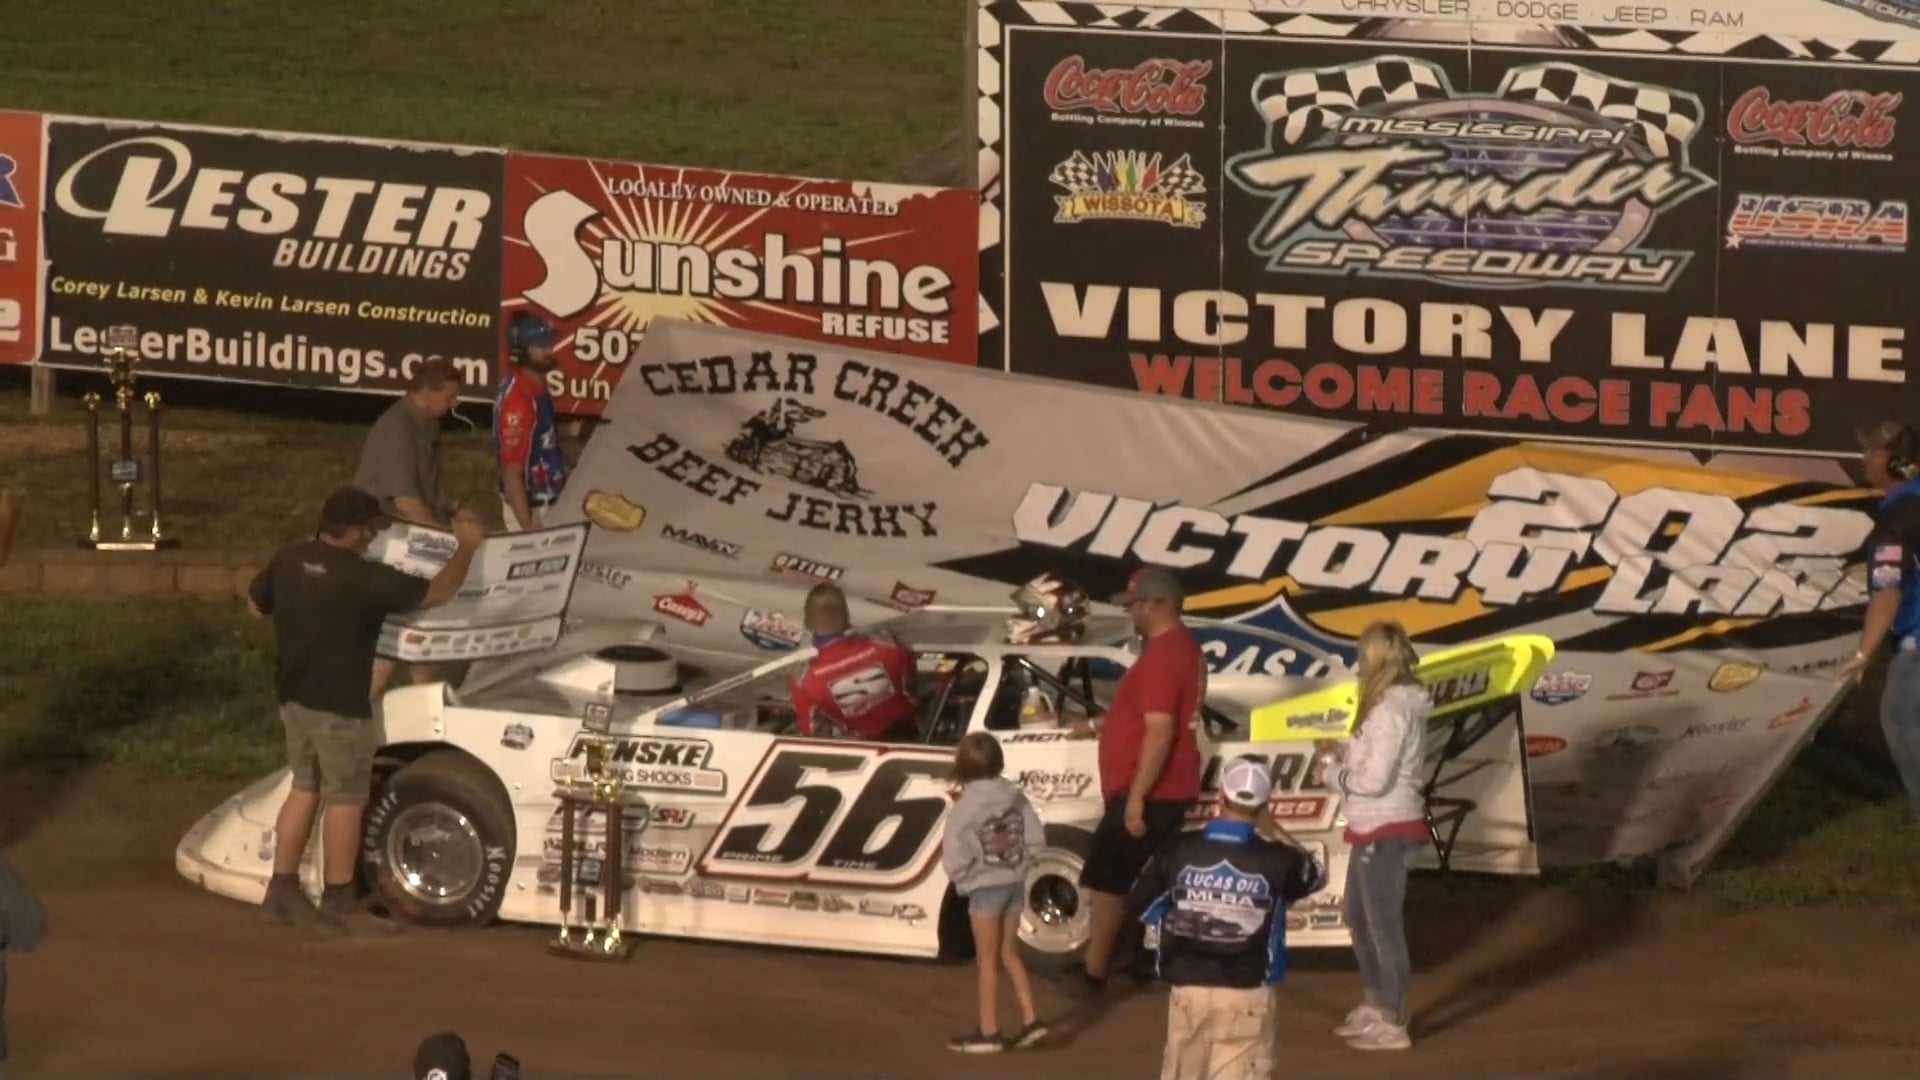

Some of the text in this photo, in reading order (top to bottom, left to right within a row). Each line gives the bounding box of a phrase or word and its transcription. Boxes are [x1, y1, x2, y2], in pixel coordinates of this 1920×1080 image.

[1498, 1, 1580, 22] DODGE
[1603, 4, 1668, 25] JEEP
[1690, 9, 1745, 28] RAM
[1044, 55, 1213, 114] Coca-Cola
[1051, 112, 1205, 129] Bottling Company of Winona
[1341, 115, 1629, 145] MISSISSIPPI
[1727, 85, 1903, 148] Coca-Cola
[1734, 144, 1894, 162] Bottling Company of Winona
[101, 155, 492, 251] LESTER
[607, 177, 899, 217] LOCALLY OWNED & OPERATED
[1083, 197, 1176, 219] WISSOTA
[1236, 142, 1684, 245] Thunder
[273, 238, 471, 282] BUILDINGS
[521, 189, 953, 318] Sunshine
[1284, 240, 1674, 283] SPEEDWAY
[51, 276, 491, 328] Corey Larsen & Kevin Larsen Construction
[822, 313, 950, 344] REFUSE
[1040, 281, 1907, 383] VICTORY LANE
[640, 350, 991, 468] CEDAR CREEK
[1130, 353, 1811, 436] WELCOME RACE FANS
[627, 433, 939, 539] BEEF JERKY
[1013, 482, 1573, 605] VICTORY
[774, 553, 844, 581] OPTIMA
[637, 768, 693, 787] SHOCKS
[713, 750, 957, 872] 56
[721, 851, 879, 871] PRIME TIME
[1184, 871, 1261, 894] LUCAS OIL
